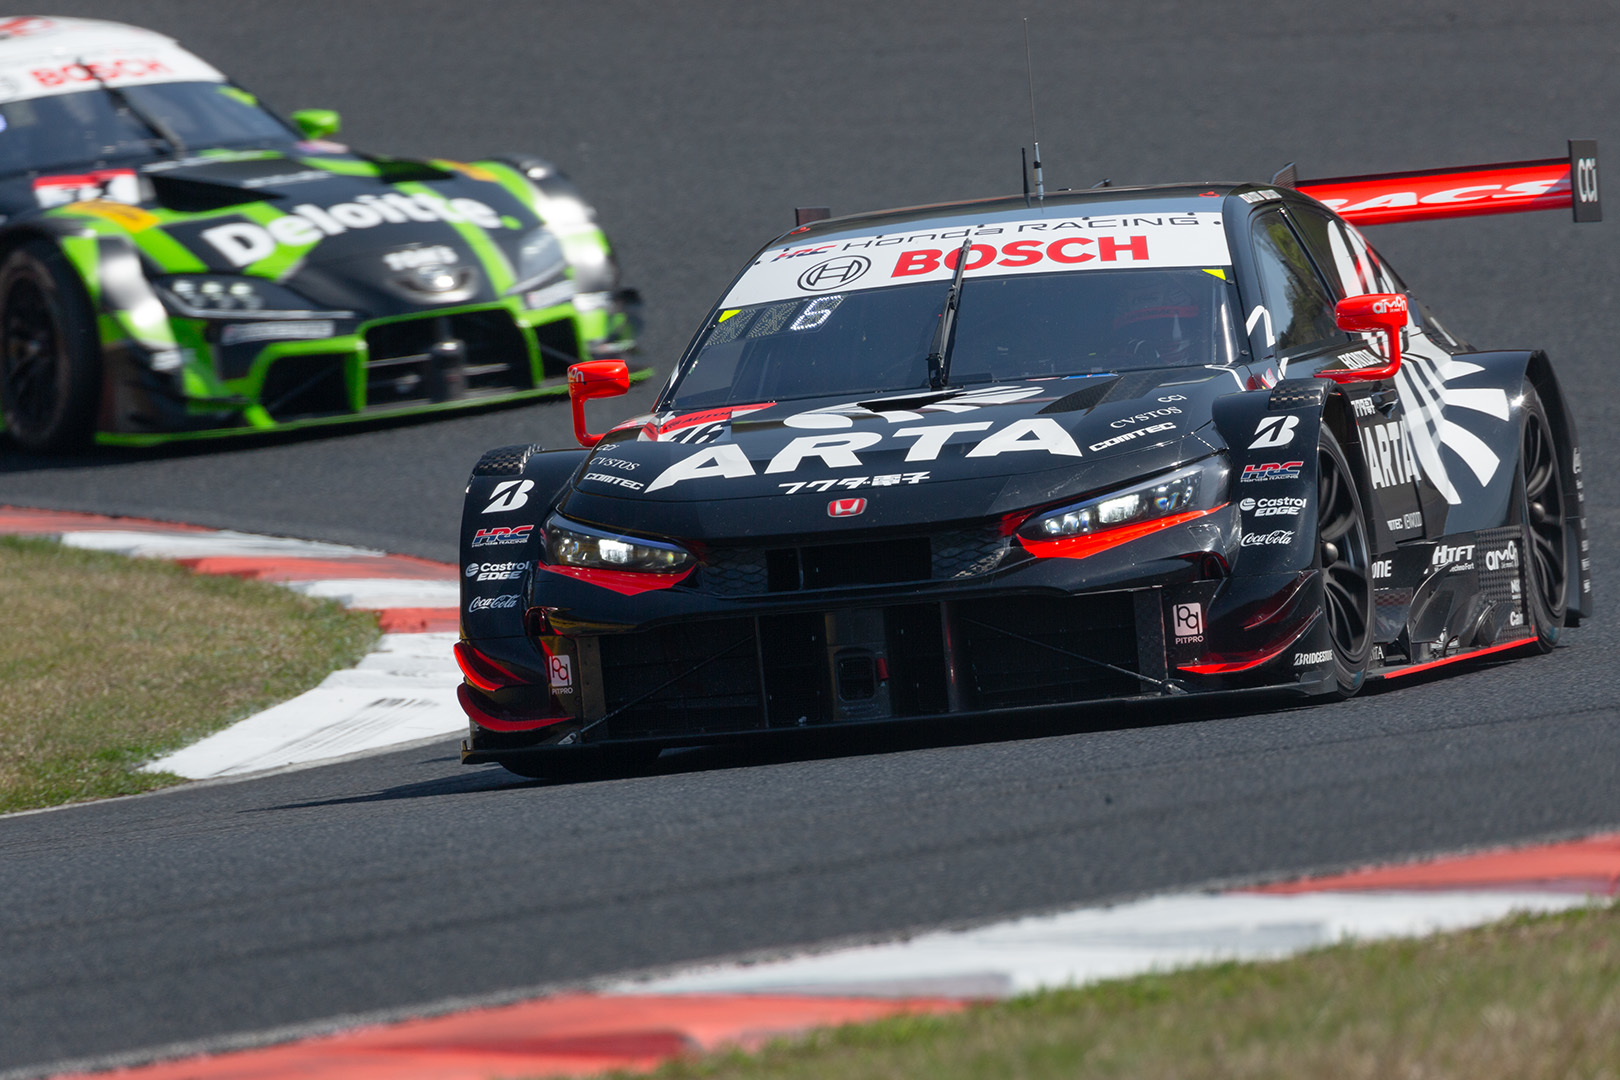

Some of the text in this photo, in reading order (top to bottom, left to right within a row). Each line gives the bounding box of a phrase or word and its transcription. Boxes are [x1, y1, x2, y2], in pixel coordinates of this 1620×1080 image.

[1018, 216, 1200, 233] RACING
[891, 233, 1149, 278] BOSCH
[1088, 421, 1177, 452] COMTEC
[644, 418, 1083, 494] ARTA
[1364, 421, 1421, 489] ARTA
[1241, 461, 1304, 480] HRC
[583, 472, 645, 490] COMTEC
[1257, 496, 1307, 508] Castrol
[1254, 506, 1300, 517] EDGE
[473, 524, 535, 545] HRC
[480, 561, 530, 571] Castrol
[477, 571, 522, 581] EDGE
[1175, 635, 1204, 644] PITPRO
[552, 687, 574, 695] PITPRO
